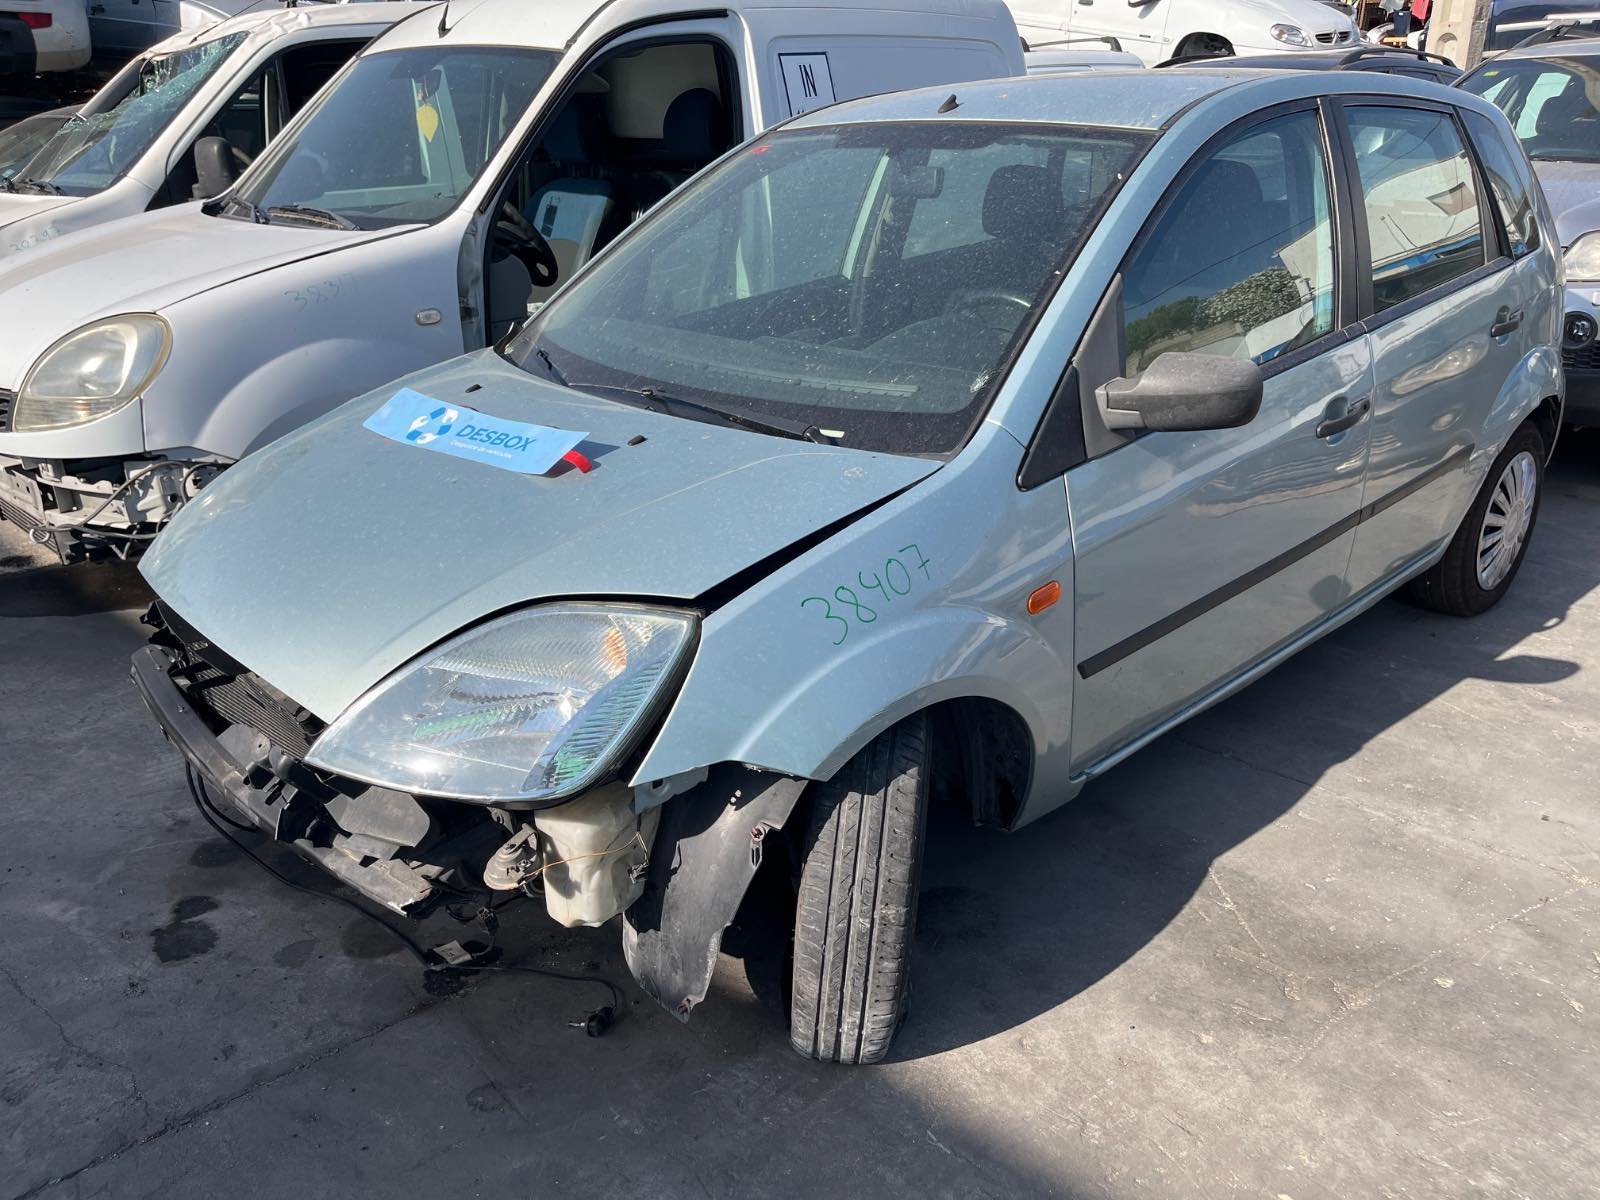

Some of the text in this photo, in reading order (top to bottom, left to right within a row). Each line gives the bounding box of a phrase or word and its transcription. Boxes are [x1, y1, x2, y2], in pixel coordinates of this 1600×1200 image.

[798, 63, 818, 98] IN
[456, 424, 537, 452] DESBOX
[801, 543, 931, 646] 38407
